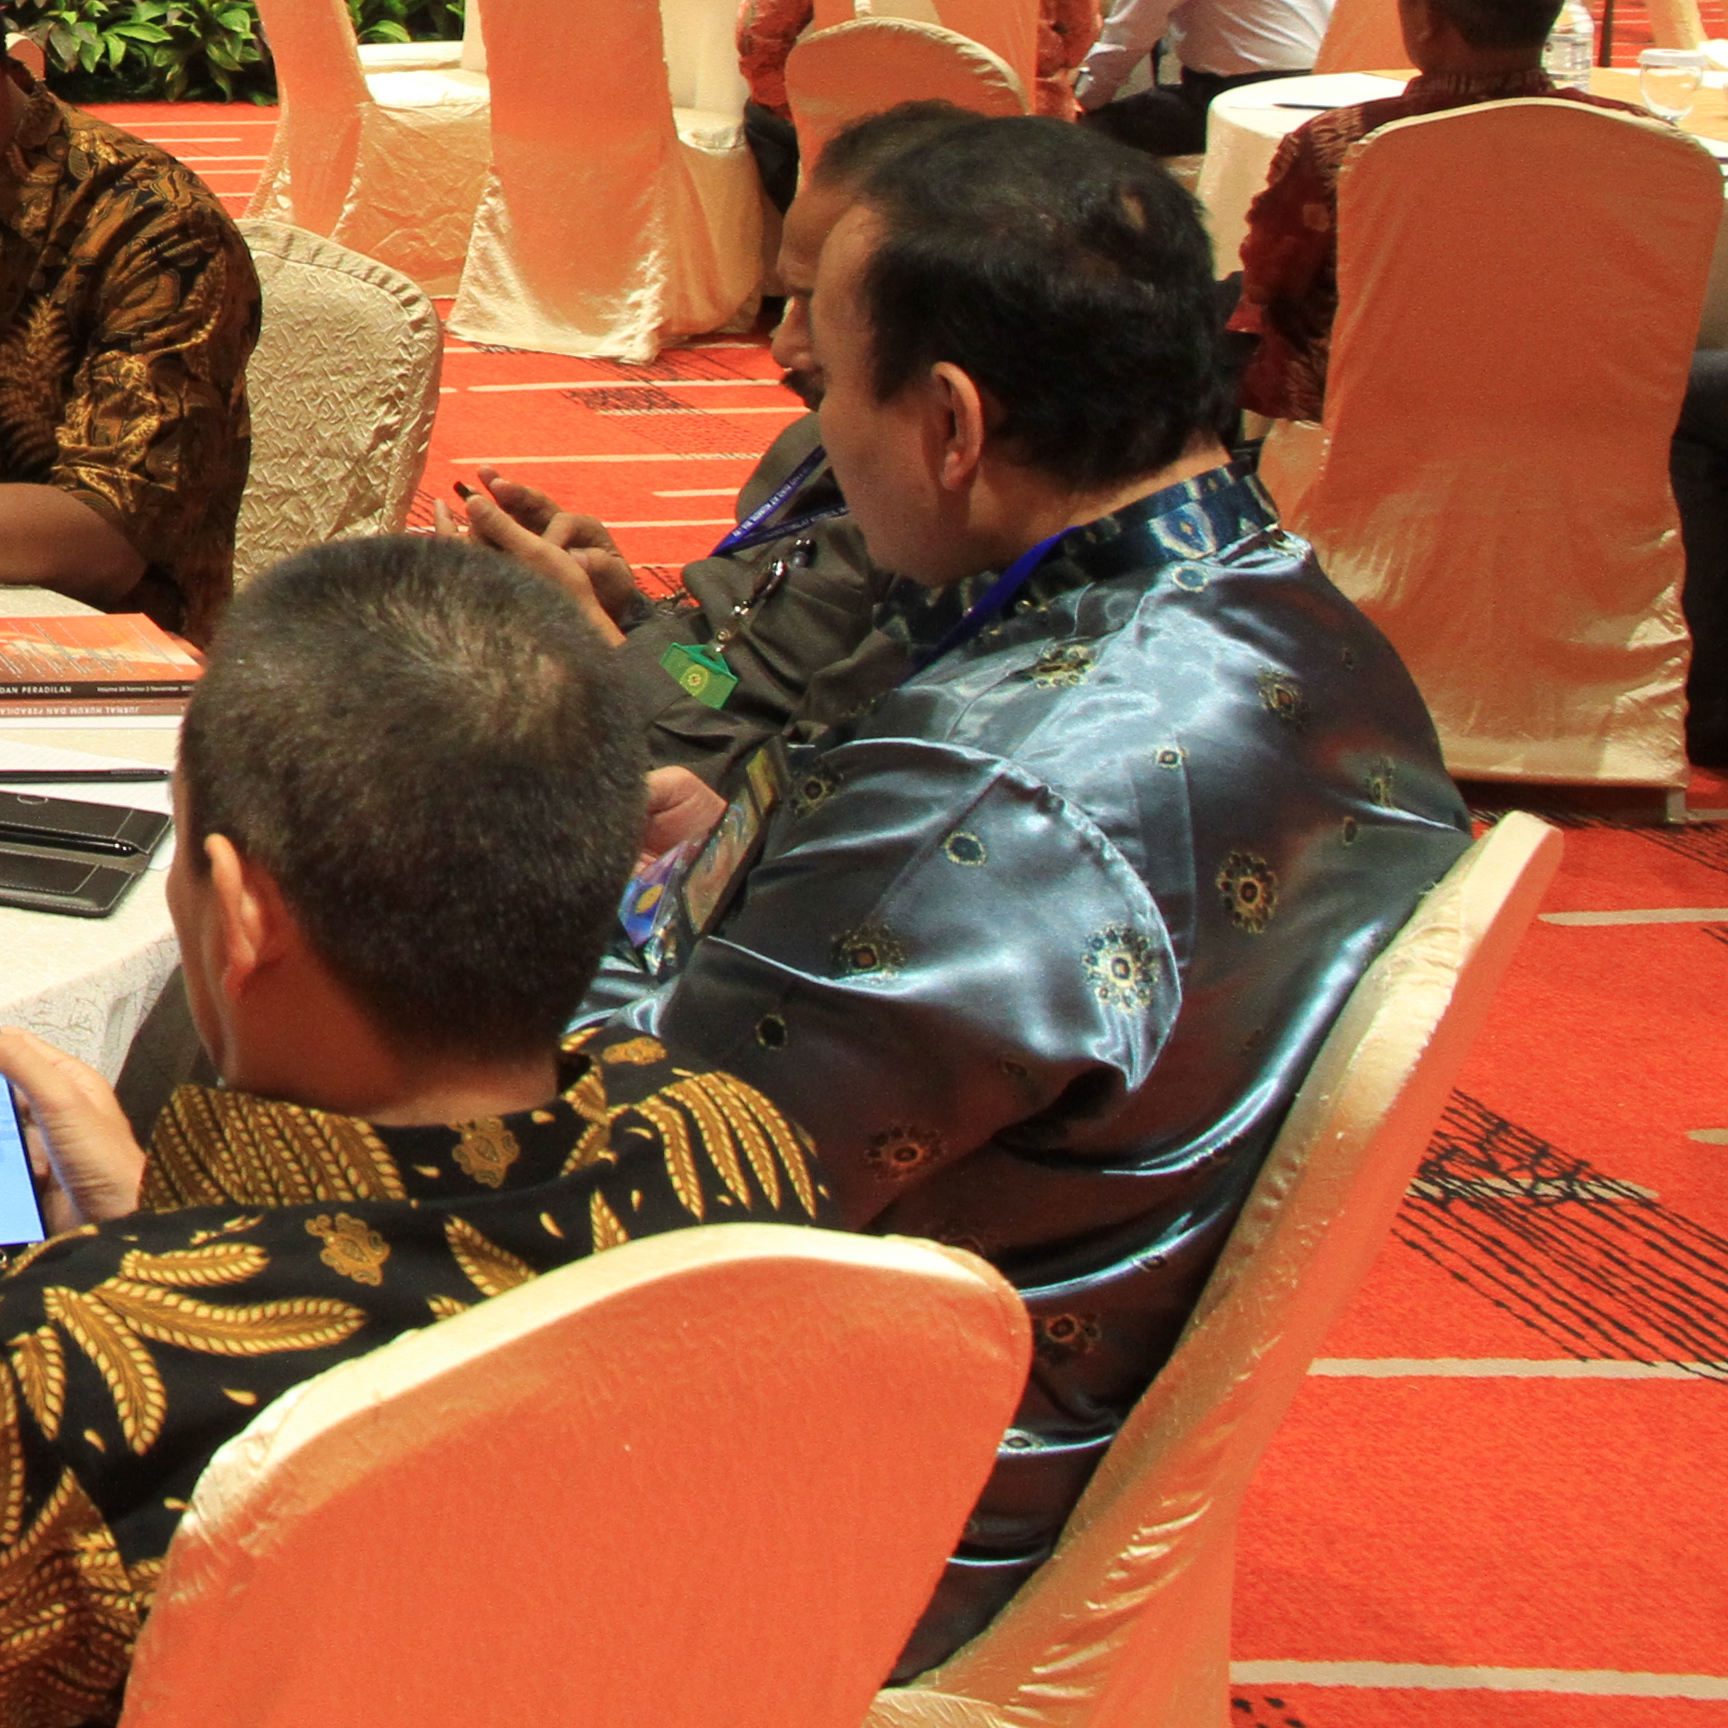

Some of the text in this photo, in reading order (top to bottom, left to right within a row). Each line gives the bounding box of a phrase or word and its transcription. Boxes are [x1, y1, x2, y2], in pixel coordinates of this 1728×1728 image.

[21, 685, 73, 694] PERADILAN
[46, 706, 68, 715] DAN
[69, 706, 103, 715] HUKUM
[105, 705, 140, 715] JURNAL
